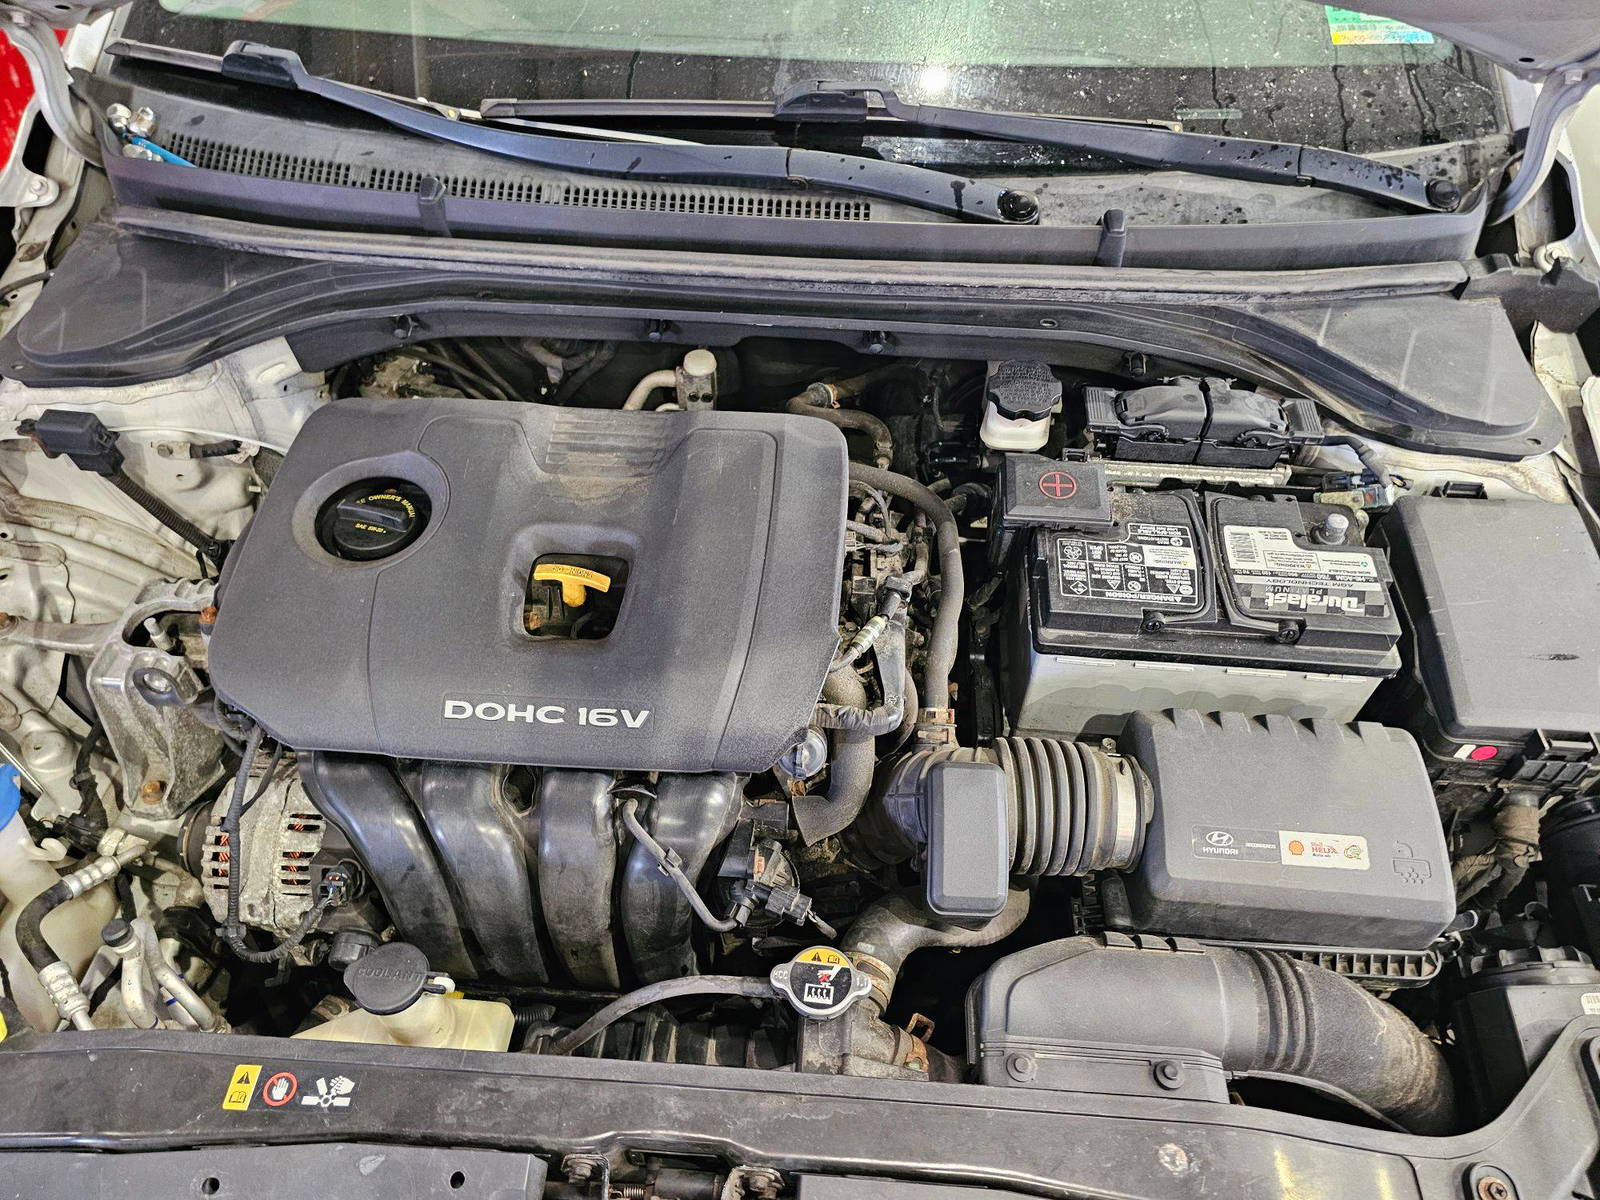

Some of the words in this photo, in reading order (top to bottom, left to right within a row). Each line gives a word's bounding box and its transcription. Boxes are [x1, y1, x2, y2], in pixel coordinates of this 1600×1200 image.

[1265, 586, 1323, 597] PLATINUM
[1265, 592, 1365, 613] Duralast
[444, 700, 566, 724] DOHC
[578, 707, 649, 728] 16V
[1203, 847, 1239, 856] HYUNDAI
[358, 967, 422, 982] COOLANT
